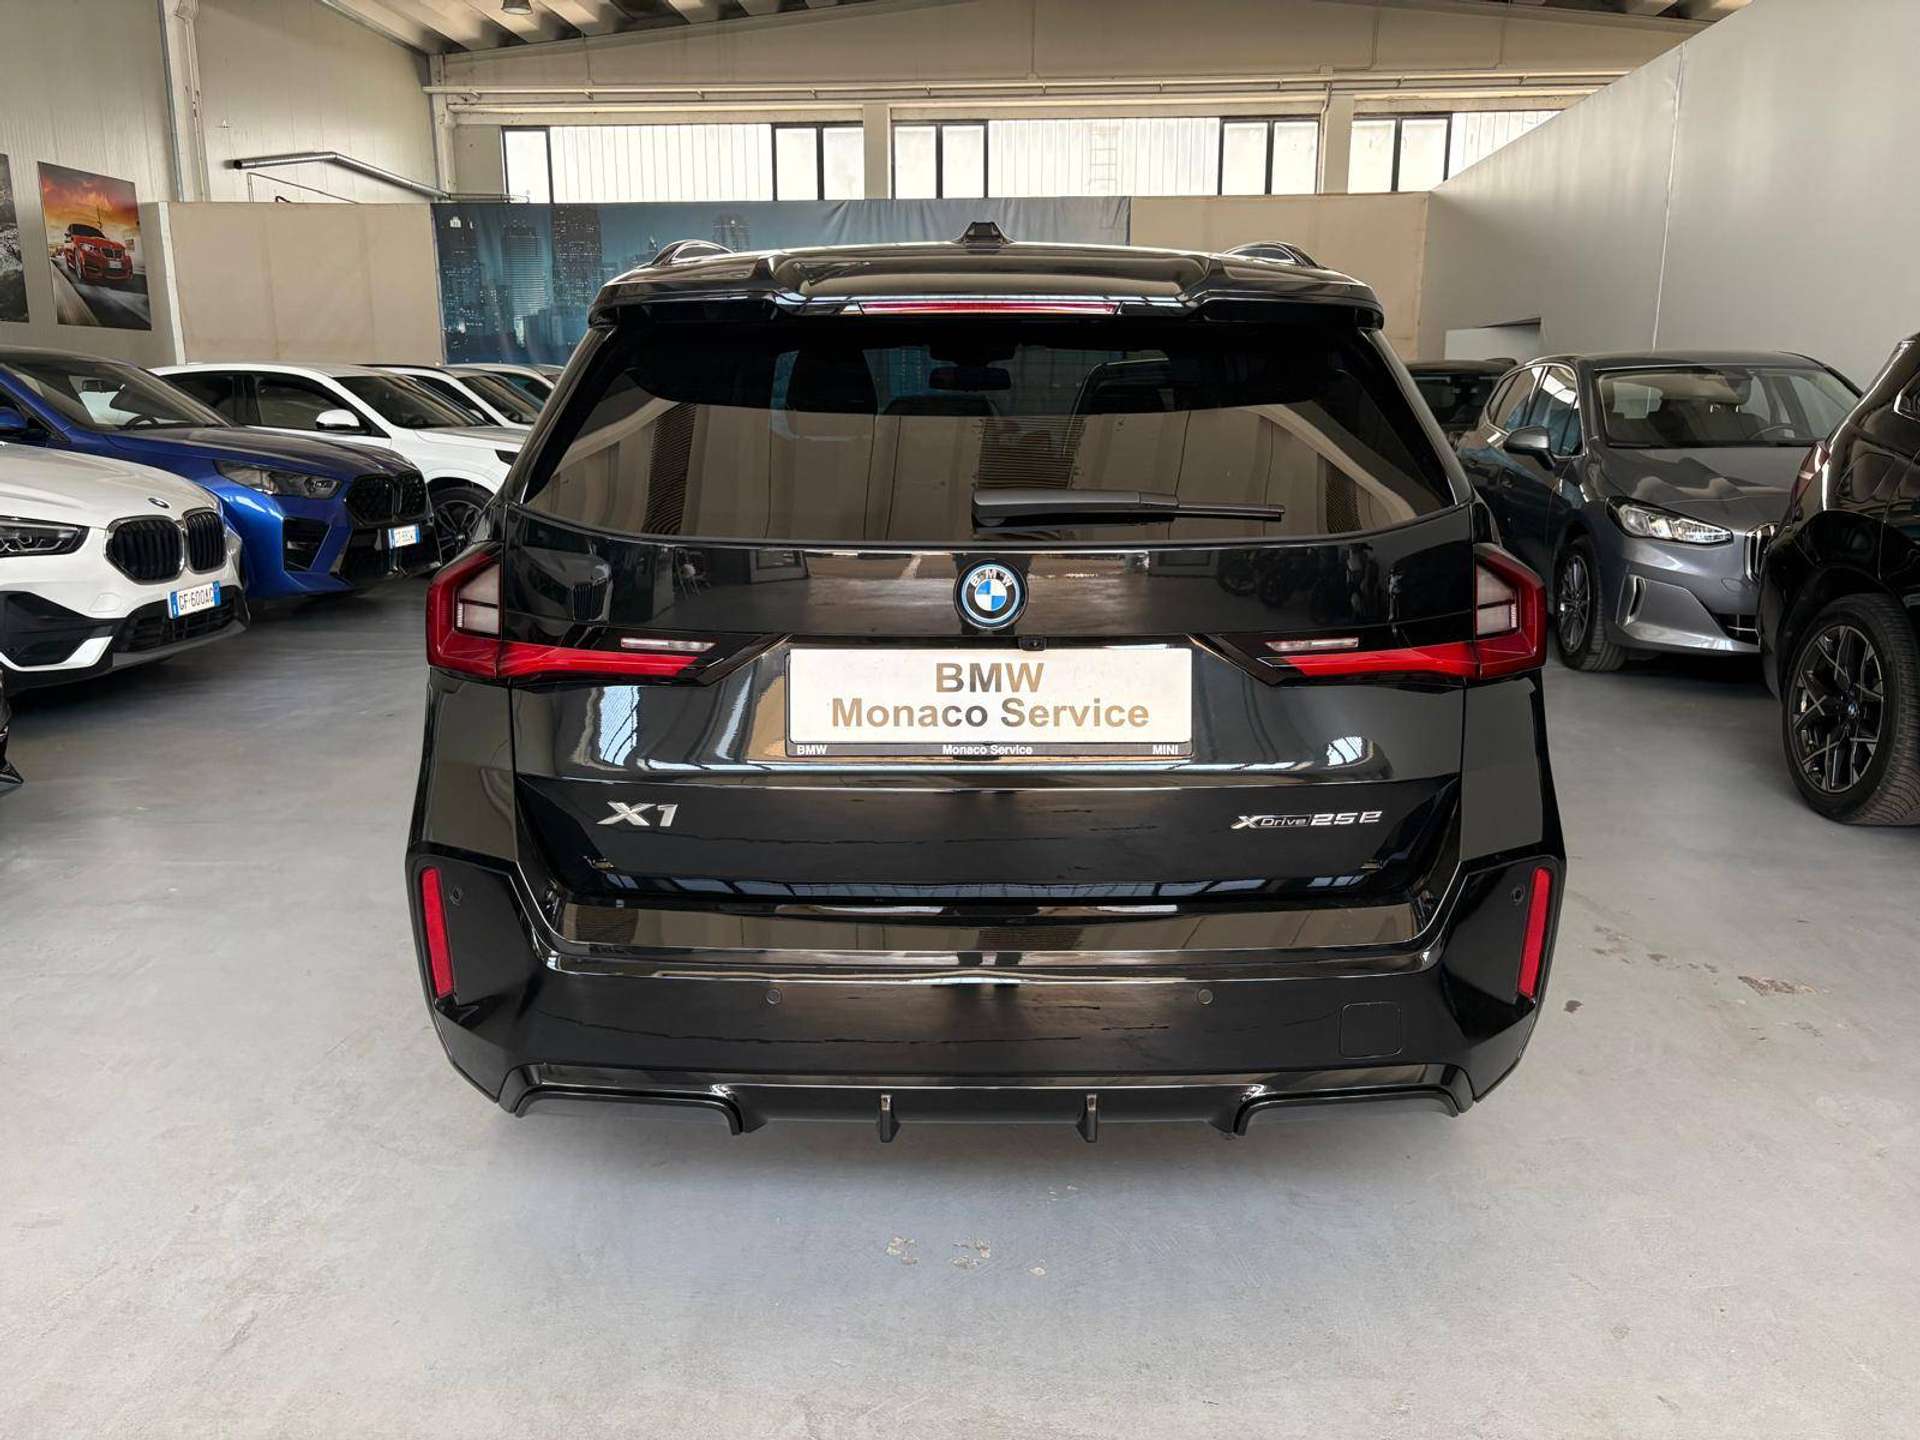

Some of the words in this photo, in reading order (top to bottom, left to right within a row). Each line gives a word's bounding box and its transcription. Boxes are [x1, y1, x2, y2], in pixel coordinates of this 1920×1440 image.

[969, 568, 1014, 588] BMW
[936, 662, 1045, 693] BMW
[832, 697, 988, 728] Monaco
[1000, 697, 1150, 728] Service
[796, 744, 828, 756] BMW
[942, 744, 988, 756] Monaco
[990, 744, 1033, 756] Service
[1152, 744, 1180, 756] MINI
[596, 801, 679, 828] X1
